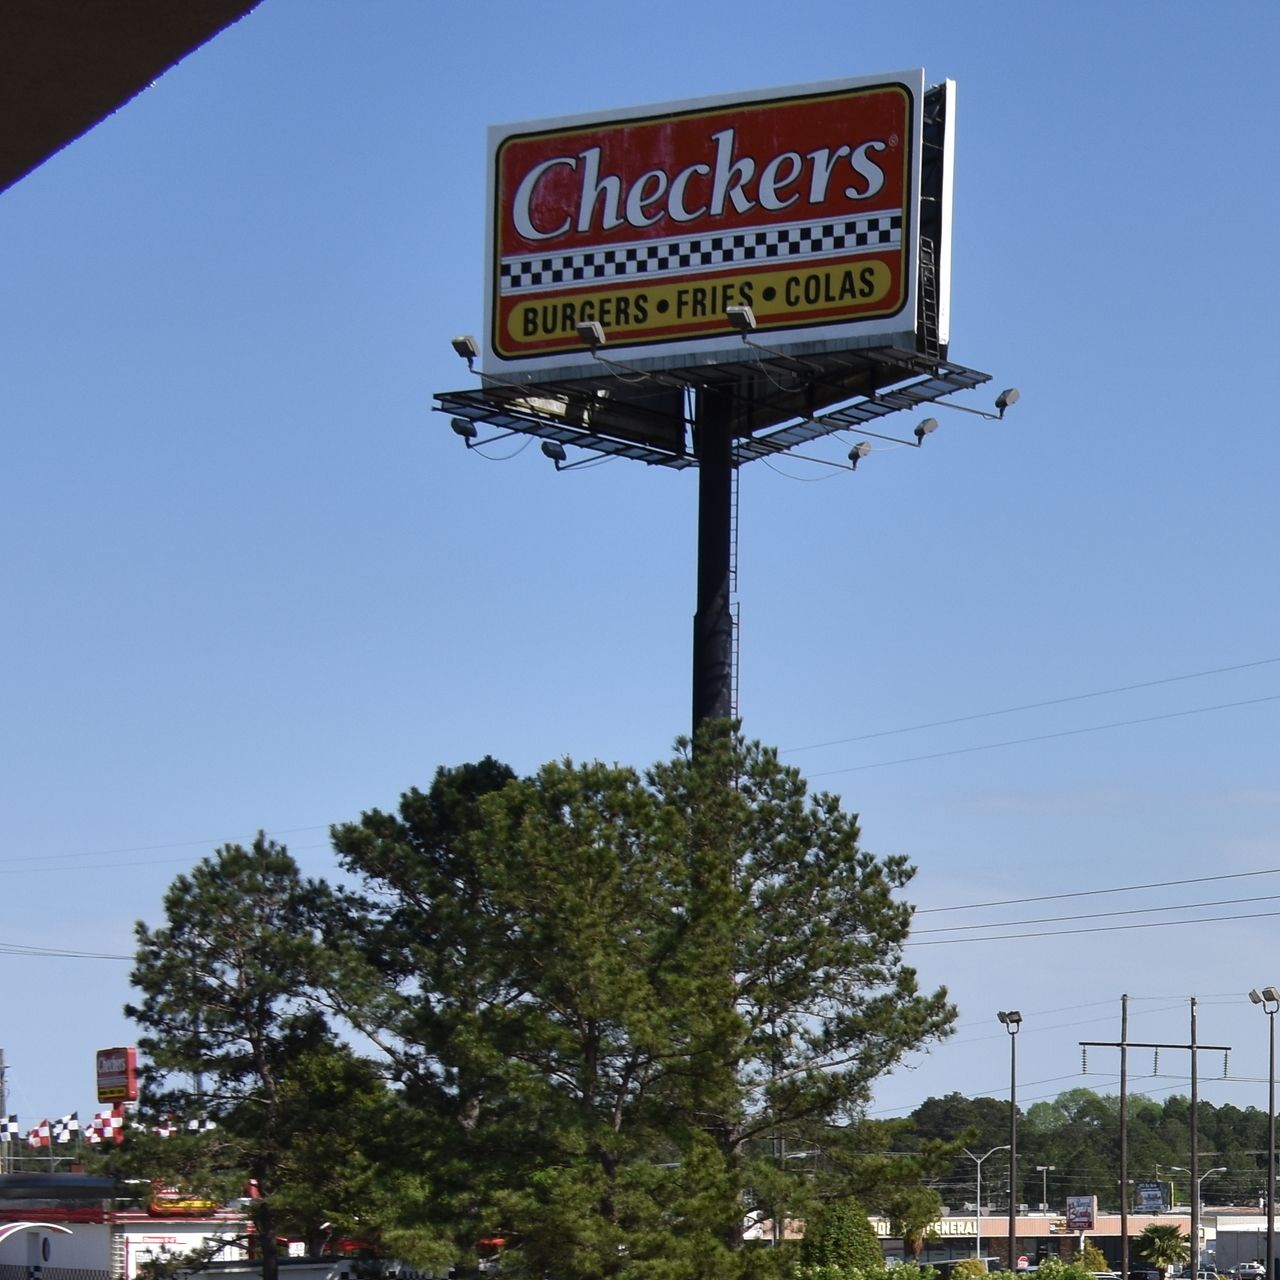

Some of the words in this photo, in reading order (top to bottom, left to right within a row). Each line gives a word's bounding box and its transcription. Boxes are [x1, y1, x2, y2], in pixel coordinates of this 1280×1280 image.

[511, 126, 888, 242] Checkers
[522, 294, 649, 338] BURGERS
[676, 280, 755, 320] FRIES
[784, 266, 876, 308] COLAS
